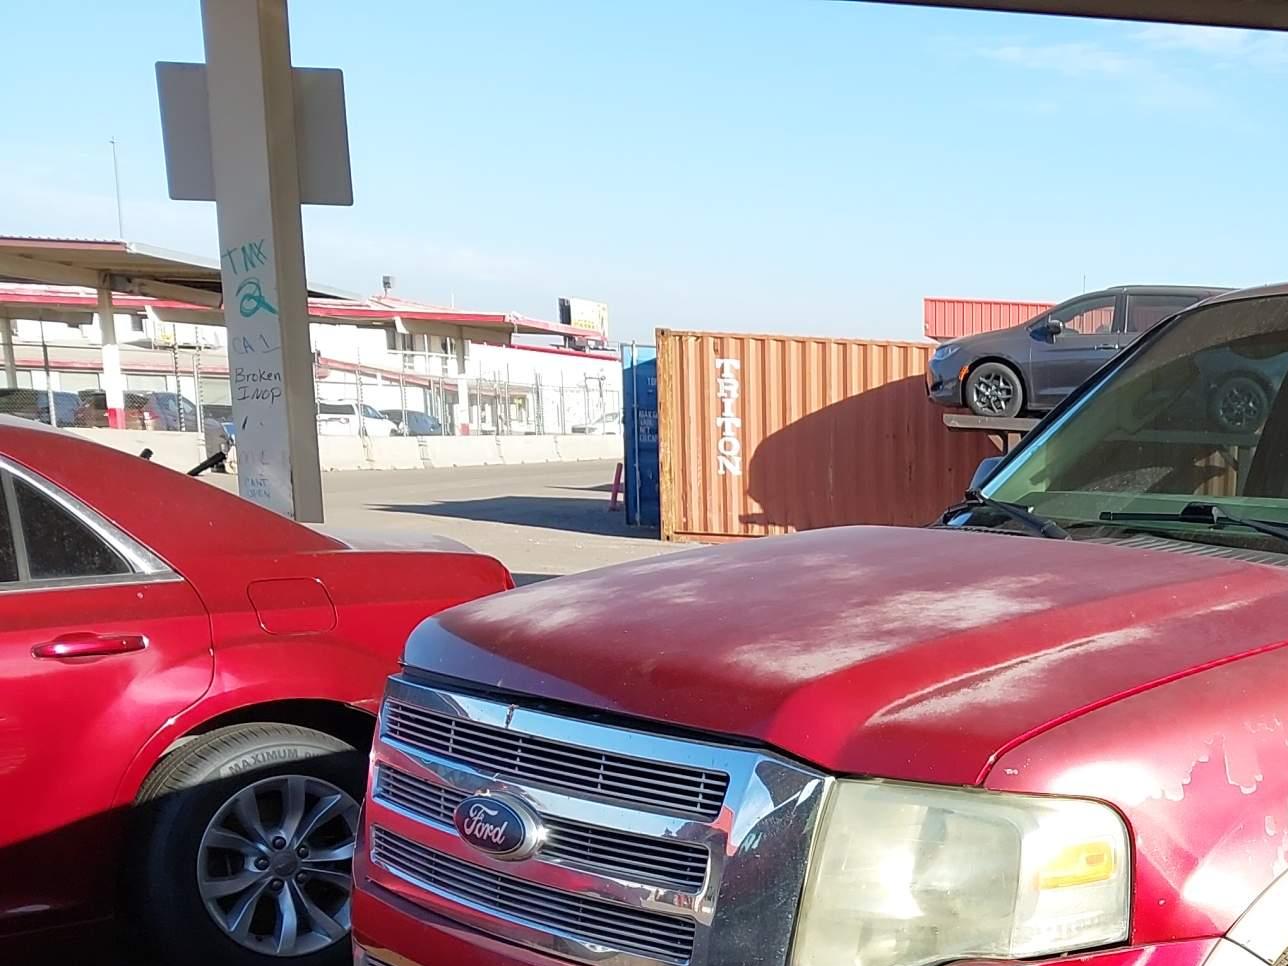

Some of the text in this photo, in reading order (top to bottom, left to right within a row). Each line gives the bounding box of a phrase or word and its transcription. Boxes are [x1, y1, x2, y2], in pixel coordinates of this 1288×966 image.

[235, 366, 282, 384] Broken
[715, 358, 742, 476] TRITON
[228, 748, 299, 776] MAXIMUM
[463, 803, 509, 845] Ford
